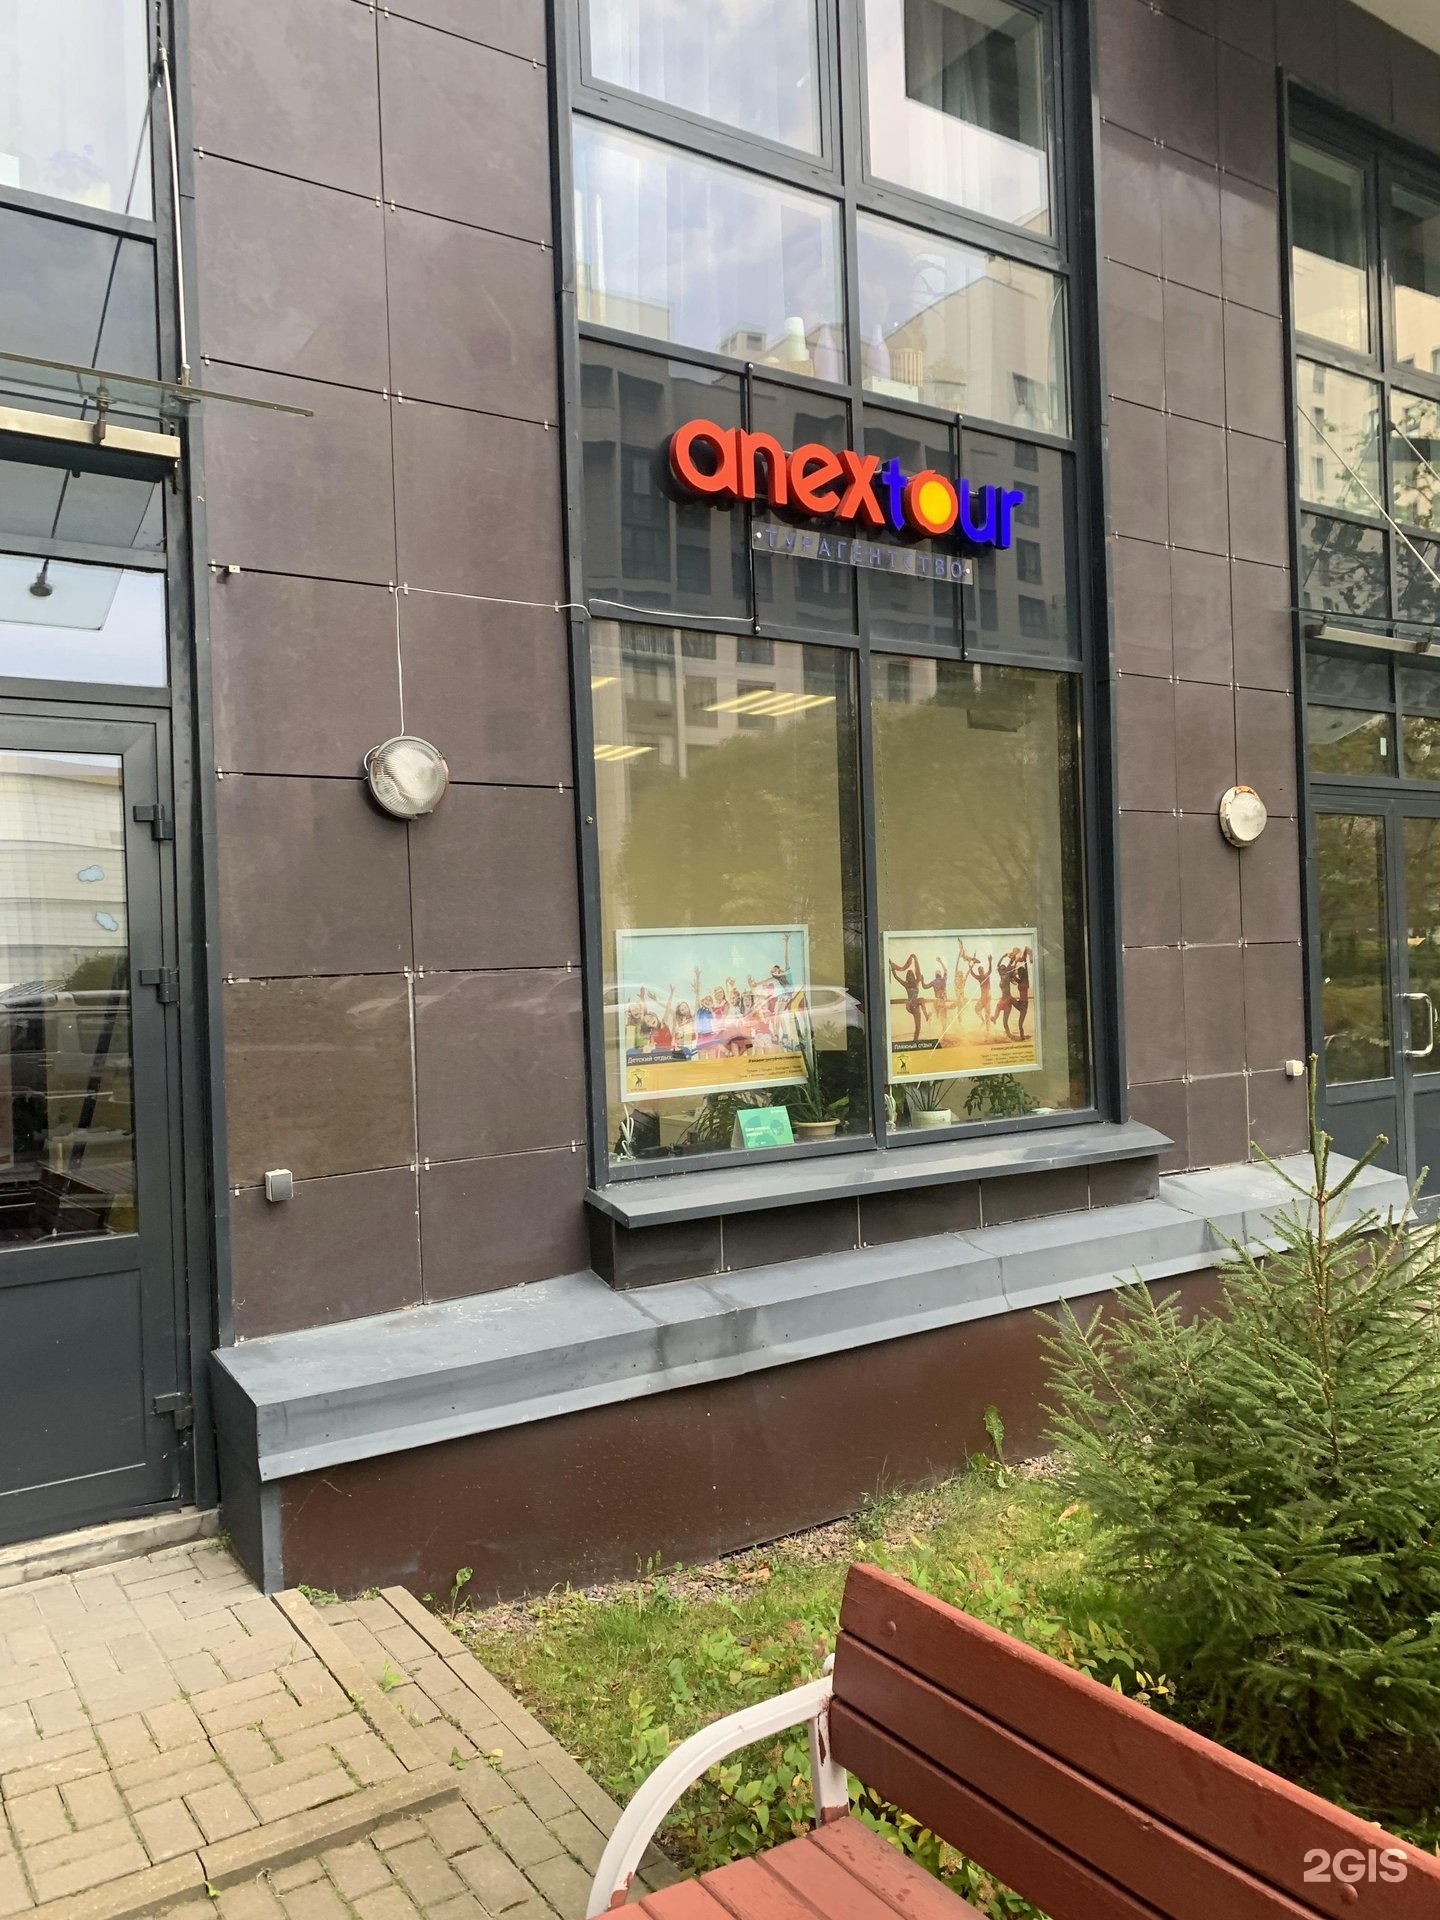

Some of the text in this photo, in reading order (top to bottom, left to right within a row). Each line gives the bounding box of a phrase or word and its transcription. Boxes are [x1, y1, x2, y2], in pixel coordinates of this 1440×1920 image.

[669, 418, 1025, 550] anextour
[765, 526, 965, 580] ТУРАГЕНТСТВО
[627, 1055, 653, 1065] Детский
